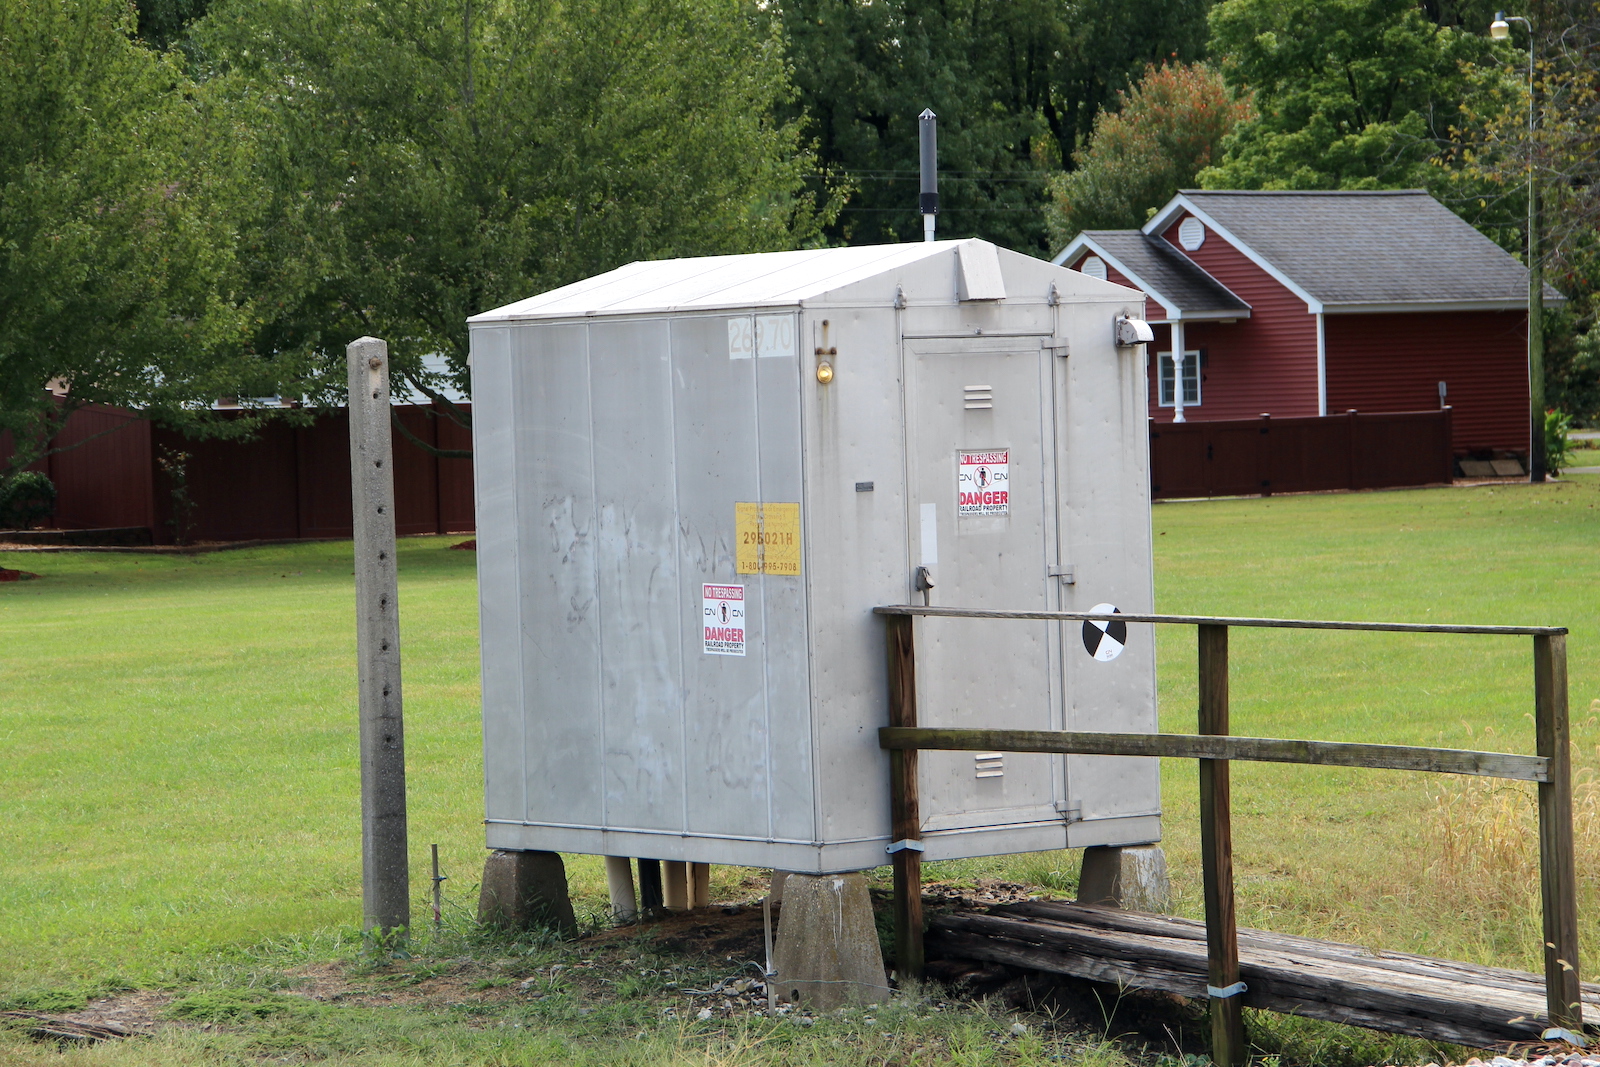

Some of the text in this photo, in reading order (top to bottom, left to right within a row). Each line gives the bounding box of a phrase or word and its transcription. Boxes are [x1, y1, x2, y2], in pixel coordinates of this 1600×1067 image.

[970, 453, 1006, 463] TRESPASSING
[960, 491, 1008, 505] DANGER
[743, 532, 793, 545] 295021H
[705, 587, 743, 599] NO TRESPASSING
[704, 608, 716, 616] CN
[732, 609, 743, 617] CN
[705, 626, 744, 642] DANGER
